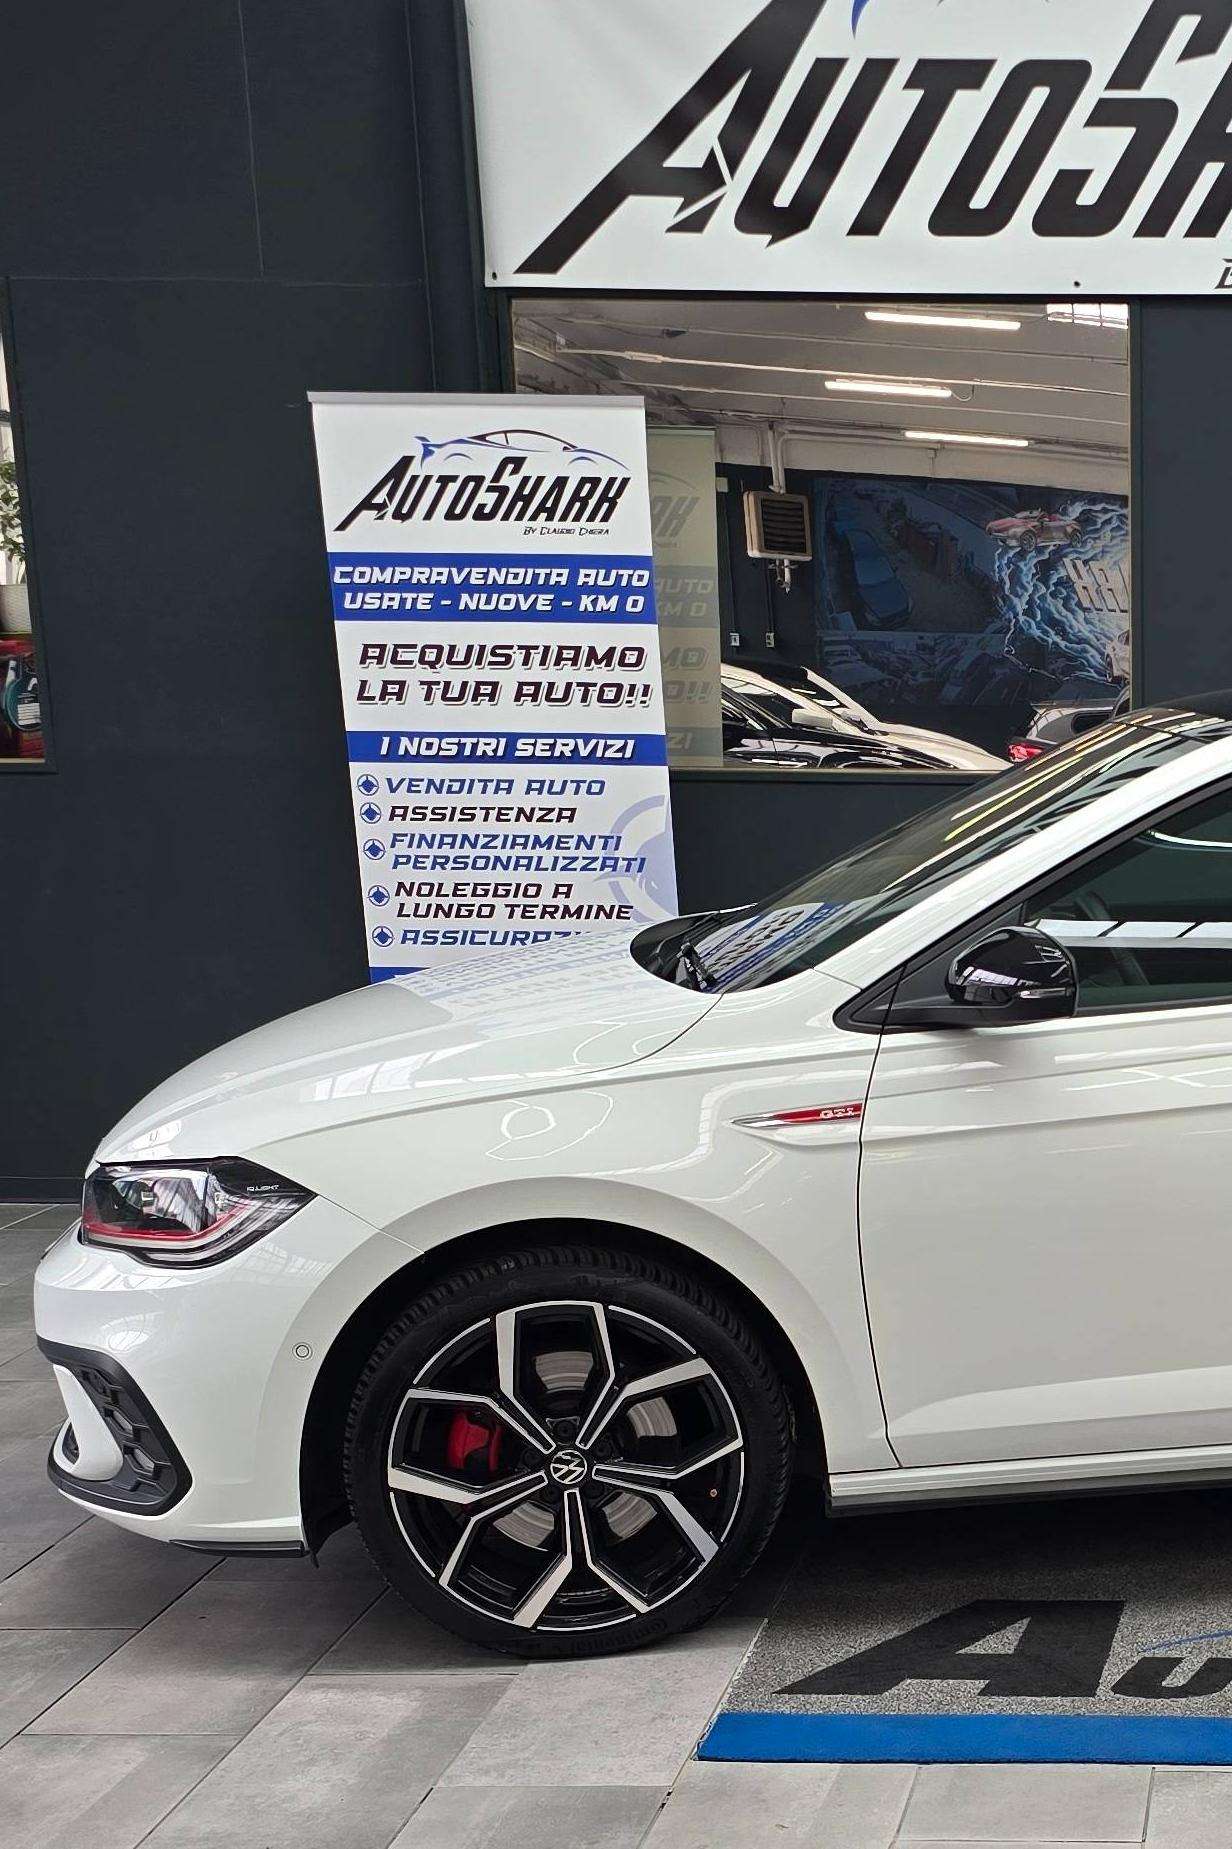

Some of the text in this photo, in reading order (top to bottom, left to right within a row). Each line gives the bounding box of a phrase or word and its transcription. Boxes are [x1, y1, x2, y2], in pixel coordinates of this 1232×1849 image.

[333, 566, 650, 587] COMPRAVENDITA AUTO
[344, 592, 434, 611] USATE
[459, 593, 554, 612] NUOVE
[579, 594, 618, 613] KM
[359, 643, 648, 672] ACQUISTIAMO
[356, 679, 406, 704] LA
[419, 679, 500, 705] TUA
[513, 680, 654, 706] AUTO!!
[379, 736, 635, 759] I NOSTRI SERVIZI
[385, 777, 606, 796] VENDITA AUTO
[388, 805, 577, 824] ASSISTENZA
[390, 833, 622, 851] FINANZIAMENTI
[392, 855, 647, 873] PERSONALIZZATI
[394, 881, 574, 899] NOLEGGIO A
[396, 903, 634, 921] LUNGO TERMINE
